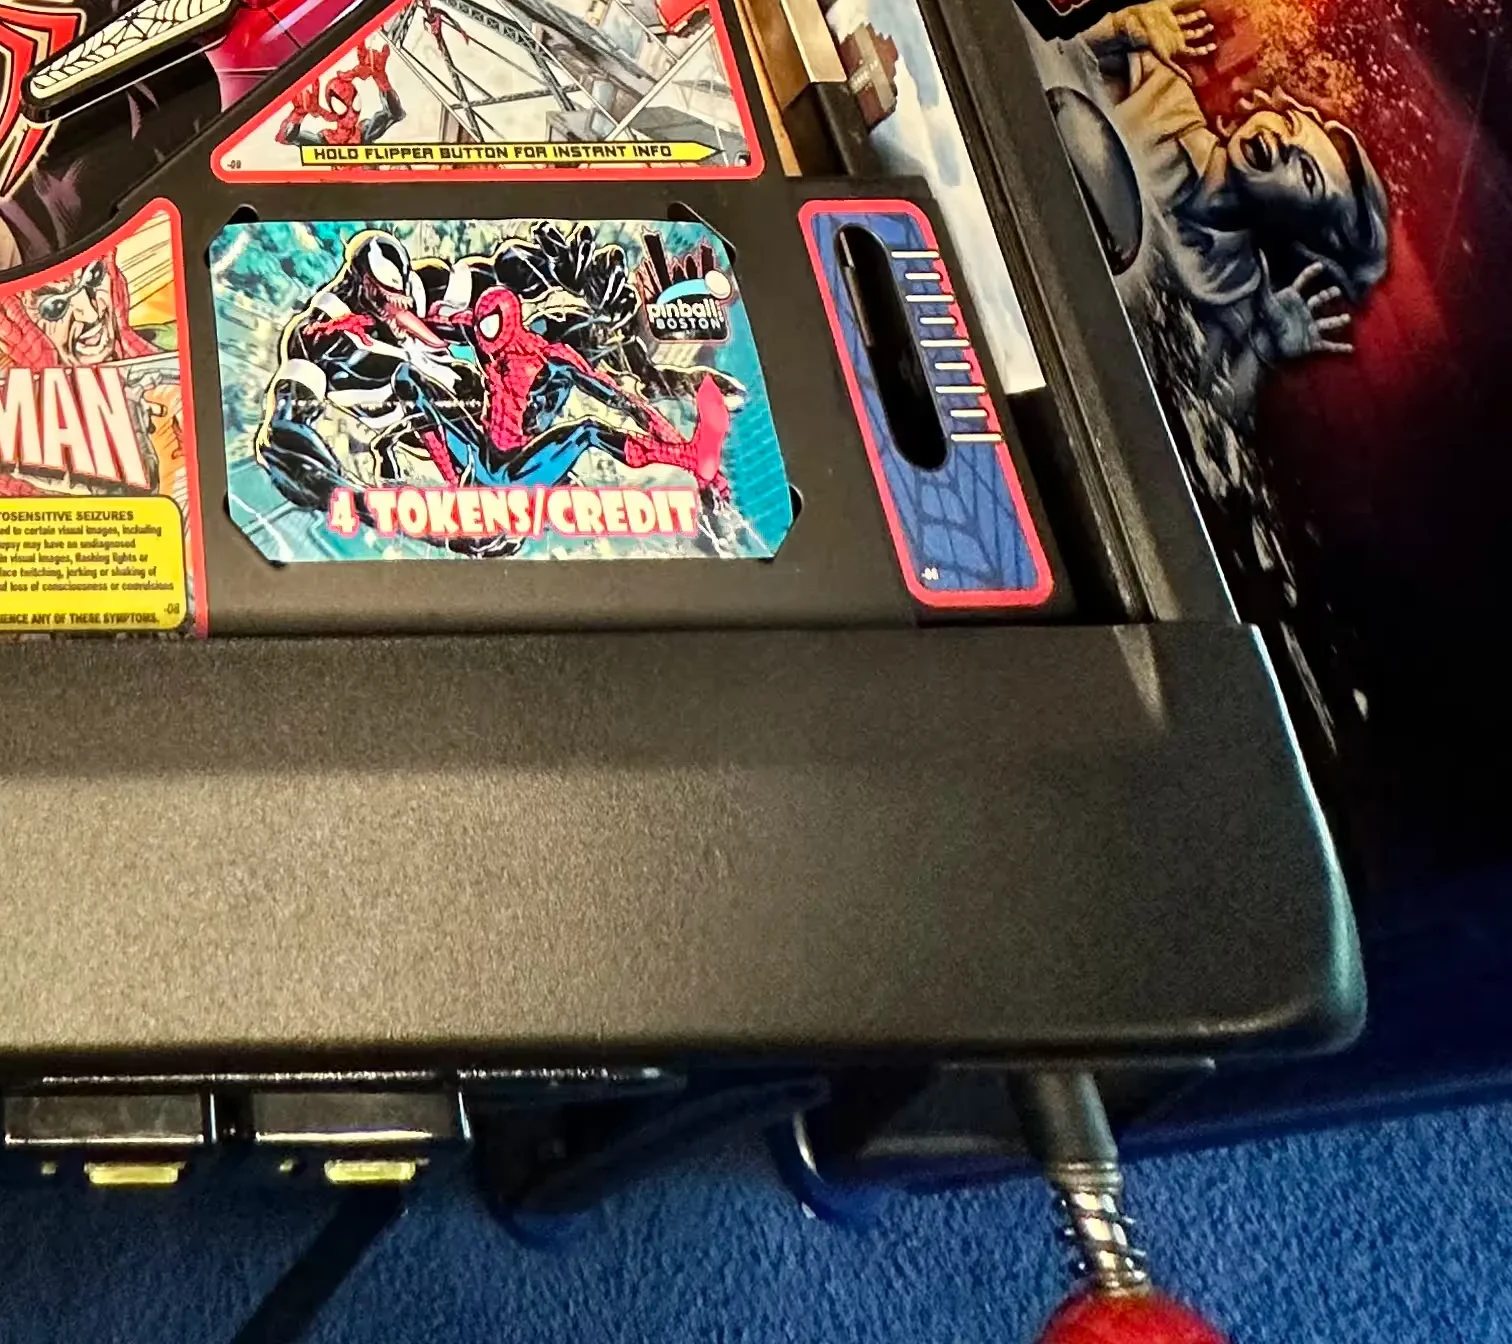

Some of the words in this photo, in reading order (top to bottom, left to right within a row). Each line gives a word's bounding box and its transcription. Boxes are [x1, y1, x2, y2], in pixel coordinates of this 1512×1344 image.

[315, 146, 359, 160] HOLD
[364, 145, 434, 160] FLIPPER
[440, 145, 509, 159] BUTTON
[514, 145, 548, 159] FOR
[553, 144, 628, 159] INSTANT
[632, 144, 671, 158] INFO
[655, 319, 721, 330] BOSTON
[77, 511, 133, 521] SEIZURES
[332, 490, 357, 533] 4
[371, 488, 697, 535] TOKENS/CREDIT
